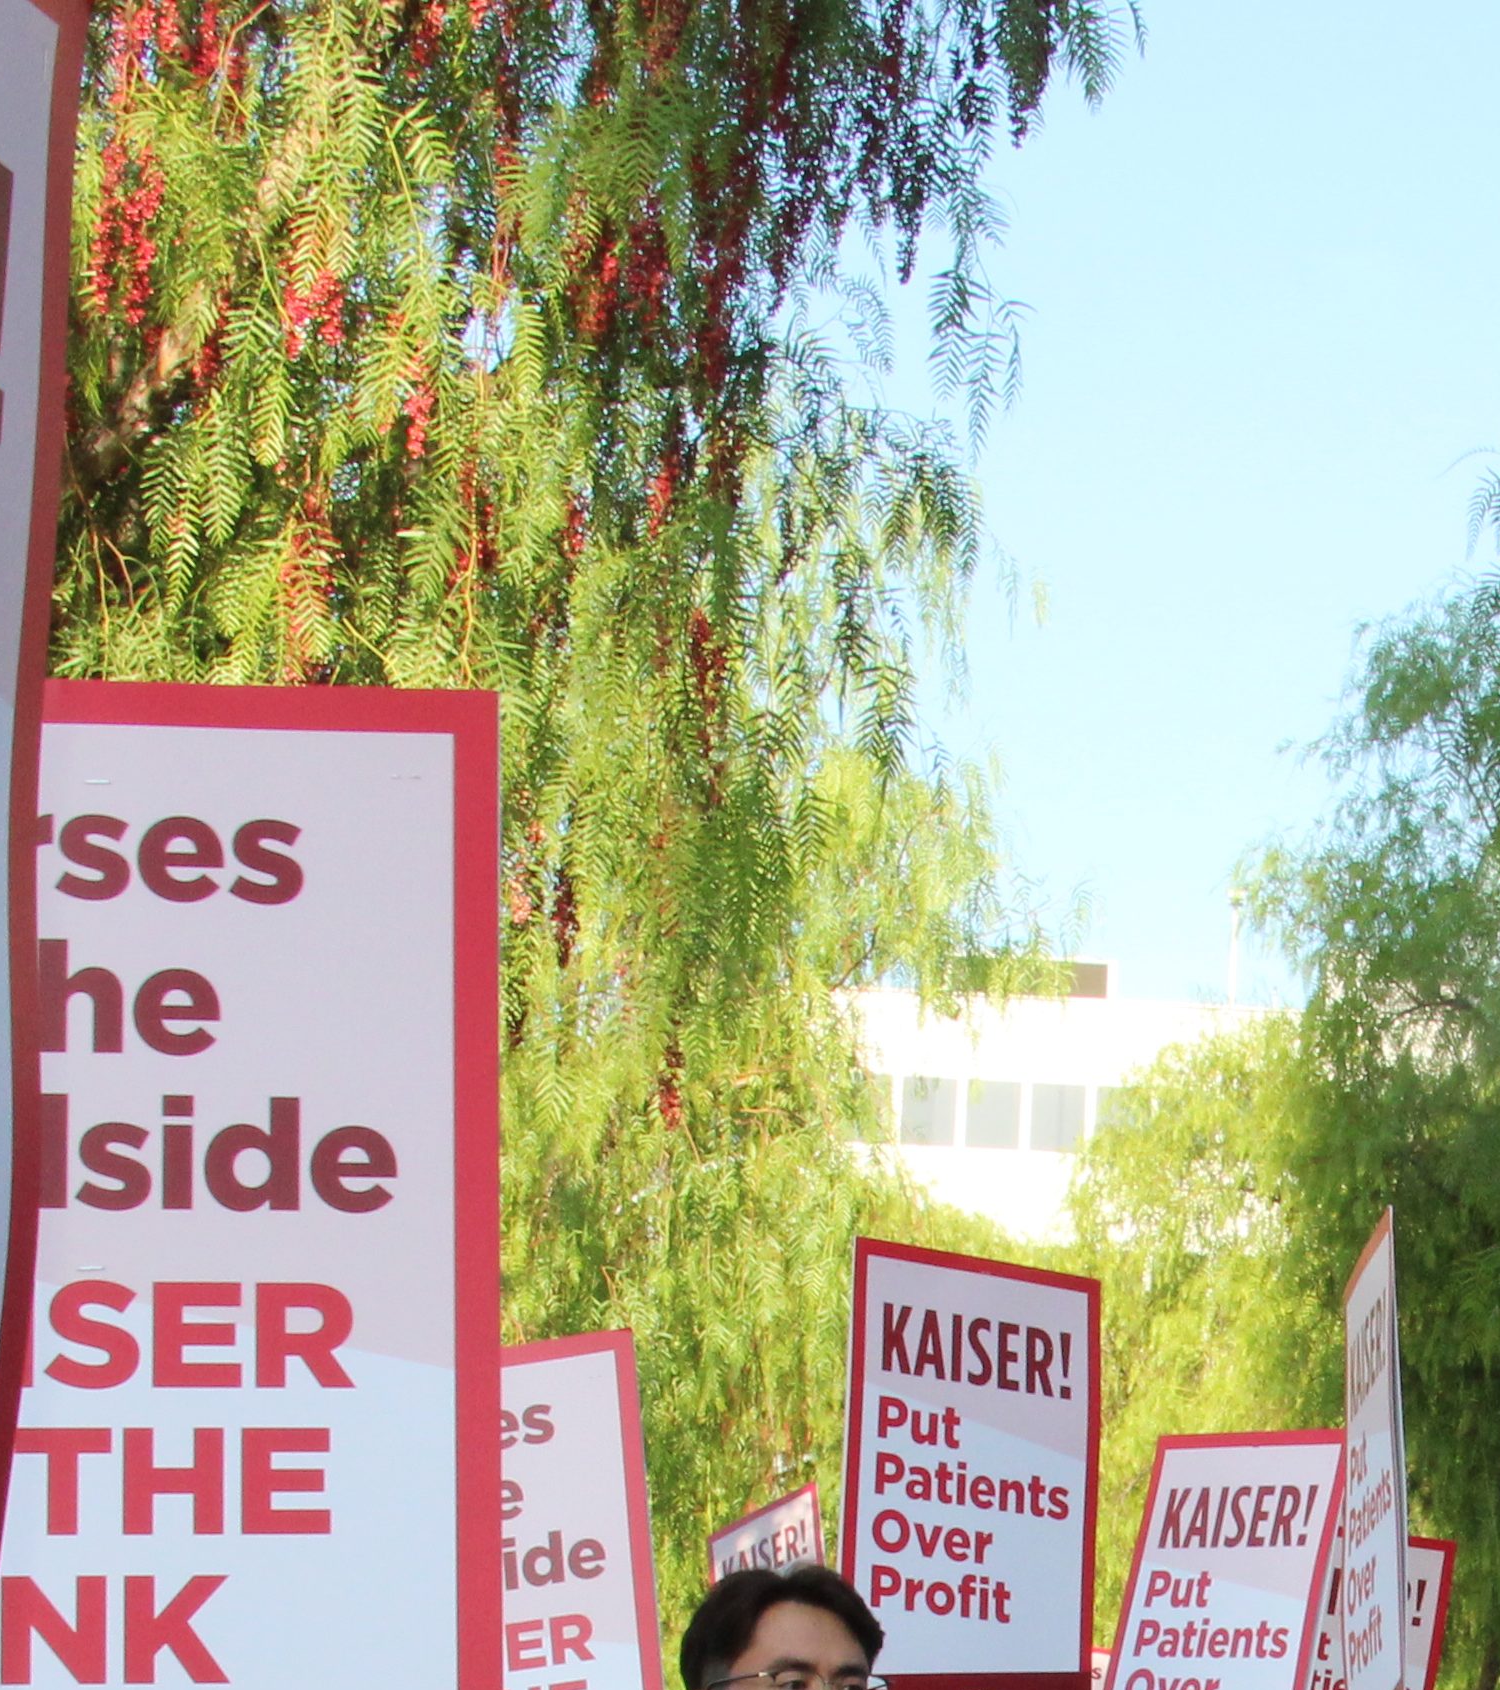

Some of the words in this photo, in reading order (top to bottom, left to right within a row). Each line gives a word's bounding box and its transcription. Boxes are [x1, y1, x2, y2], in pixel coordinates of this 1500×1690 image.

[36, 813, 305, 905] ses
[38, 938, 222, 1057] he
[39, 1092, 398, 1214] side
[23, 1279, 356, 1390] SER
[880, 1301, 1073, 1400] KAISER!
[1350, 1287, 1387, 1423] KAISER!
[876, 1396, 961, 1450] Put
[14, 1427, 332, 1536] THE
[873, 1451, 1070, 1521] Patients
[1350, 1430, 1368, 1497] Put
[871, 1508, 993, 1564] Over
[1157, 1484, 1319, 1549] KAISER!
[1349, 1468, 1392, 1557] Patients
[870, 1564, 1012, 1624] Profit
[1143, 1569, 1212, 1608] Put
[1348, 1555, 1376, 1617] Over
[1132, 1619, 1289, 1659] Patients
[1350, 1604, 1382, 1681] Profit
